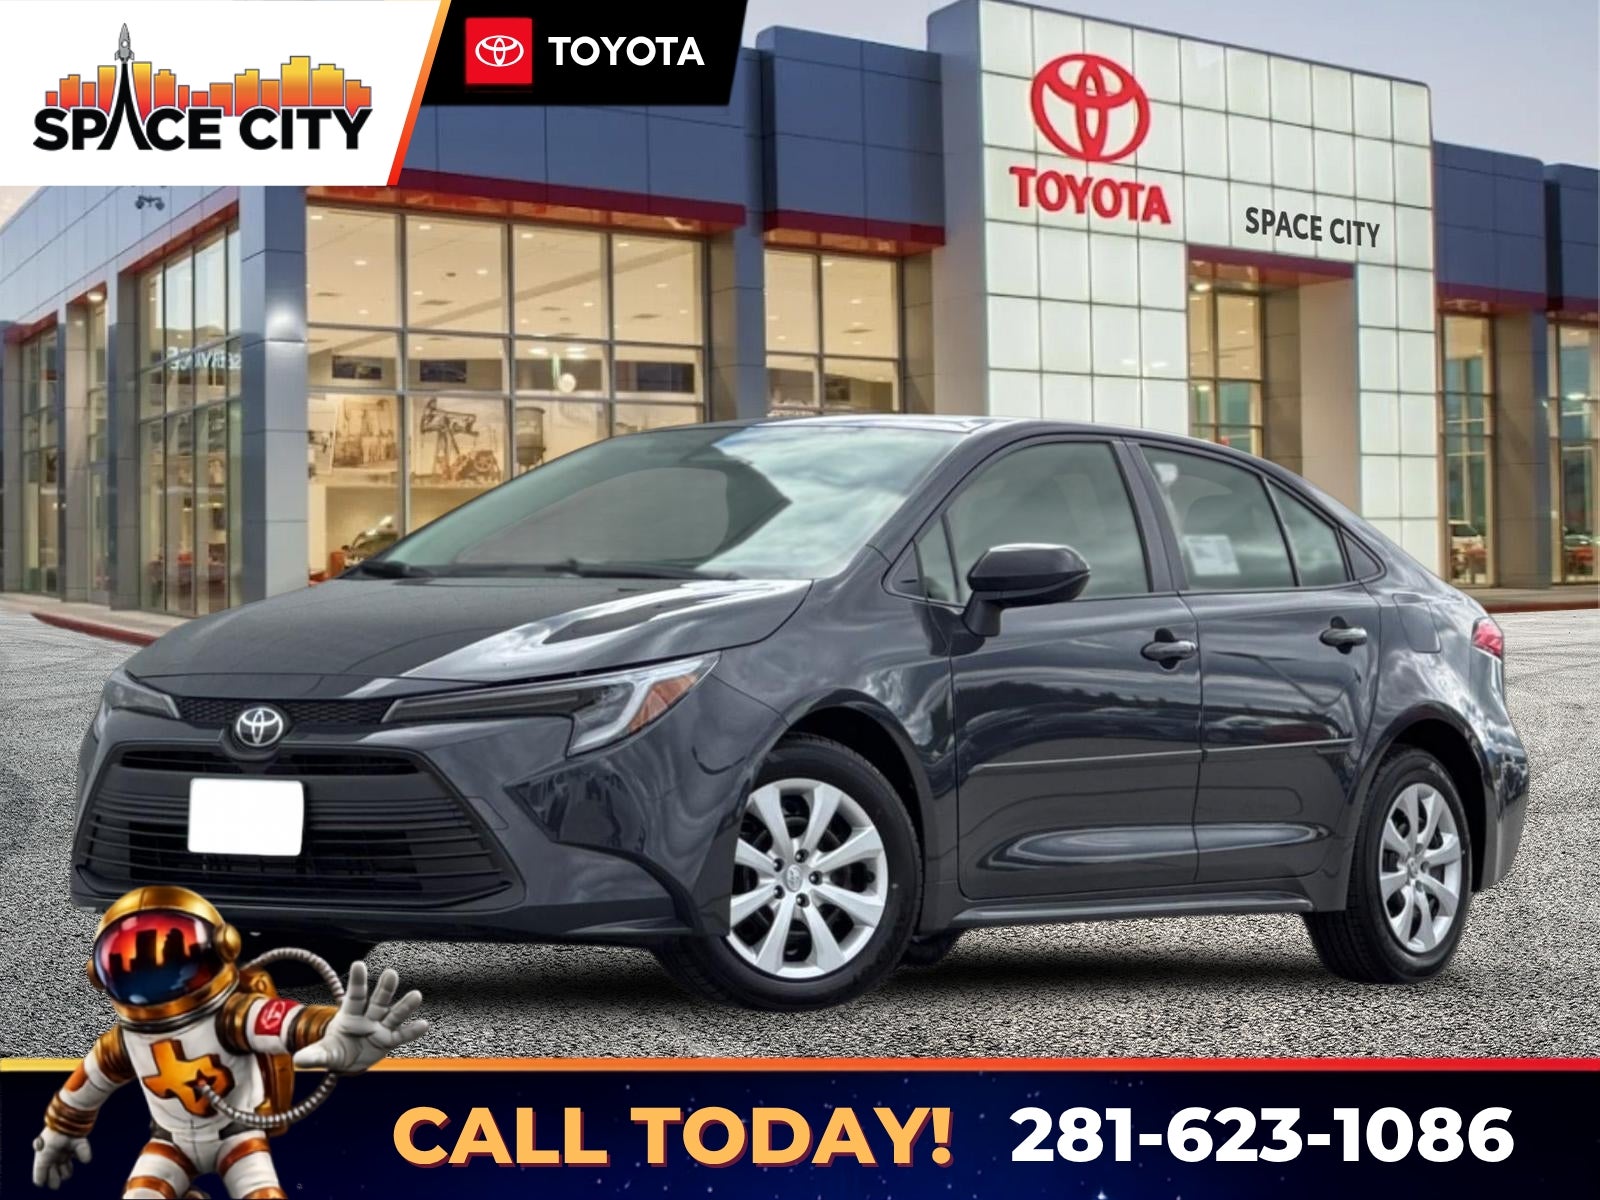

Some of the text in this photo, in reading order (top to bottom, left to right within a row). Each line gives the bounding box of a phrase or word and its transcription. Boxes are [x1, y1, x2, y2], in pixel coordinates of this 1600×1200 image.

[1009, 166, 1171, 224] TOYOTA
[1245, 207, 1381, 248] SPACE CITY
